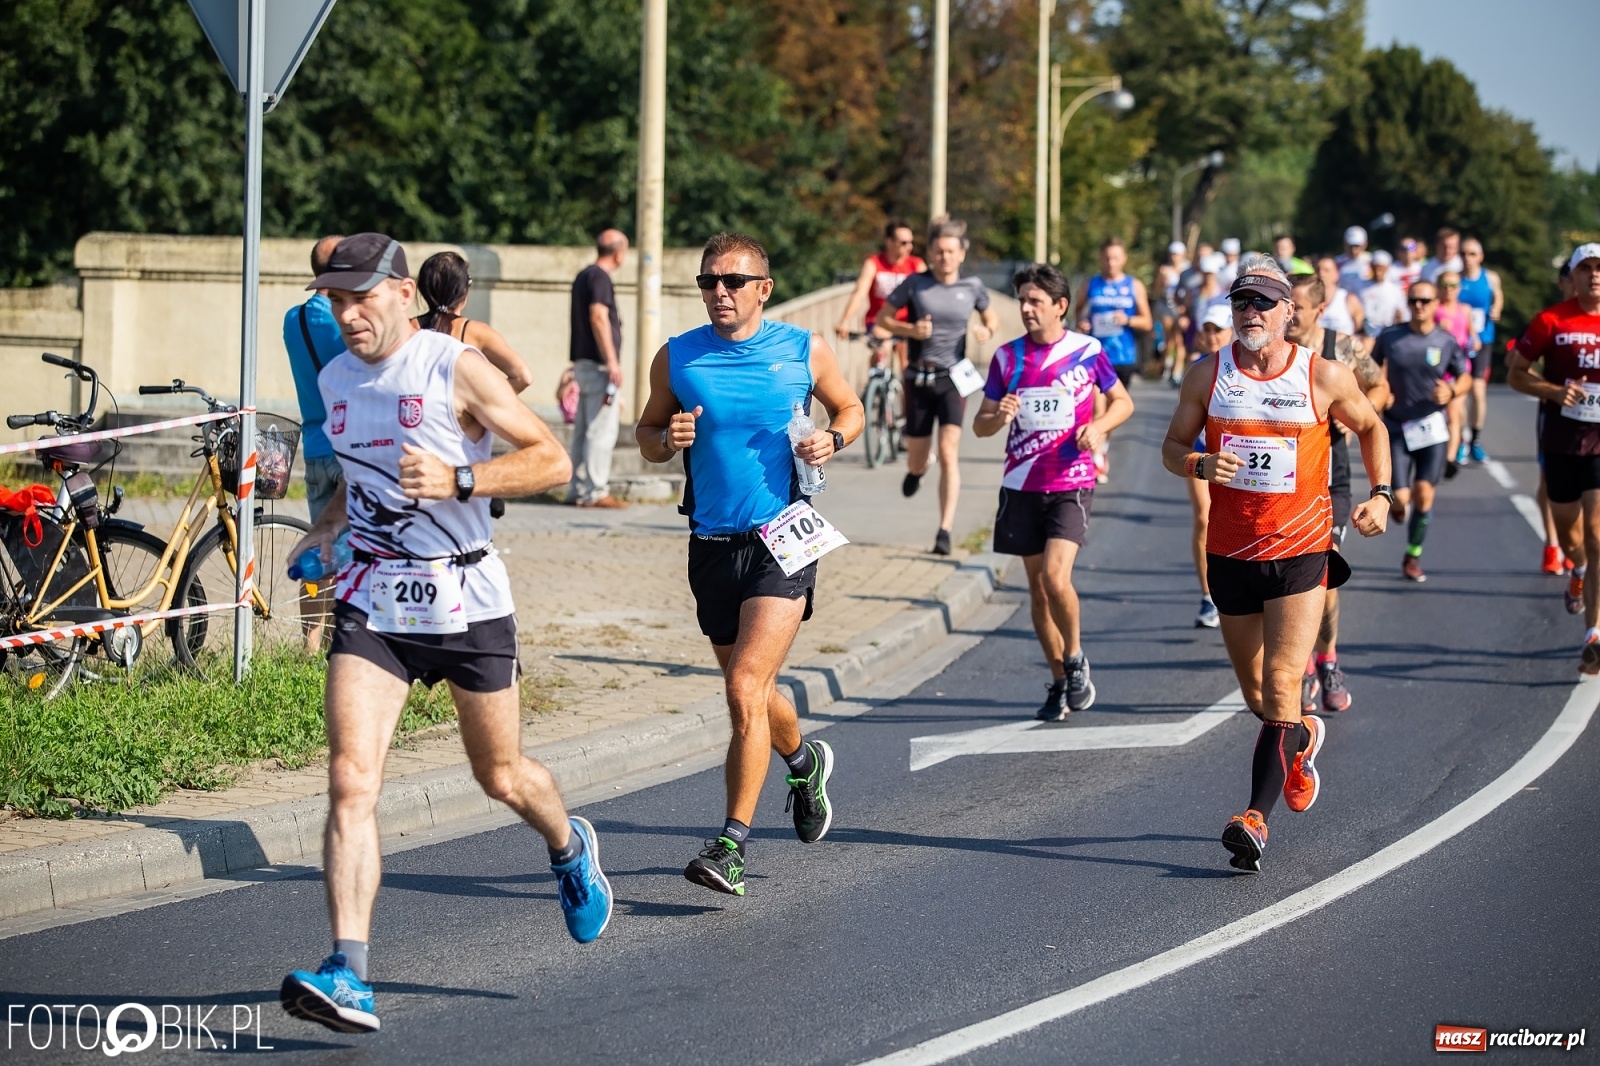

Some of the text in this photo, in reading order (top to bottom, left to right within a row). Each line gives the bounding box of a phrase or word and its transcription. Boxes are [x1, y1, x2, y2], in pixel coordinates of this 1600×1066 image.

[768, 363, 783, 372] 4F
[1034, 399, 1059, 413] 387
[1248, 452, 1271, 470] 32
[789, 511, 825, 541] 106
[394, 580, 438, 606] 209
